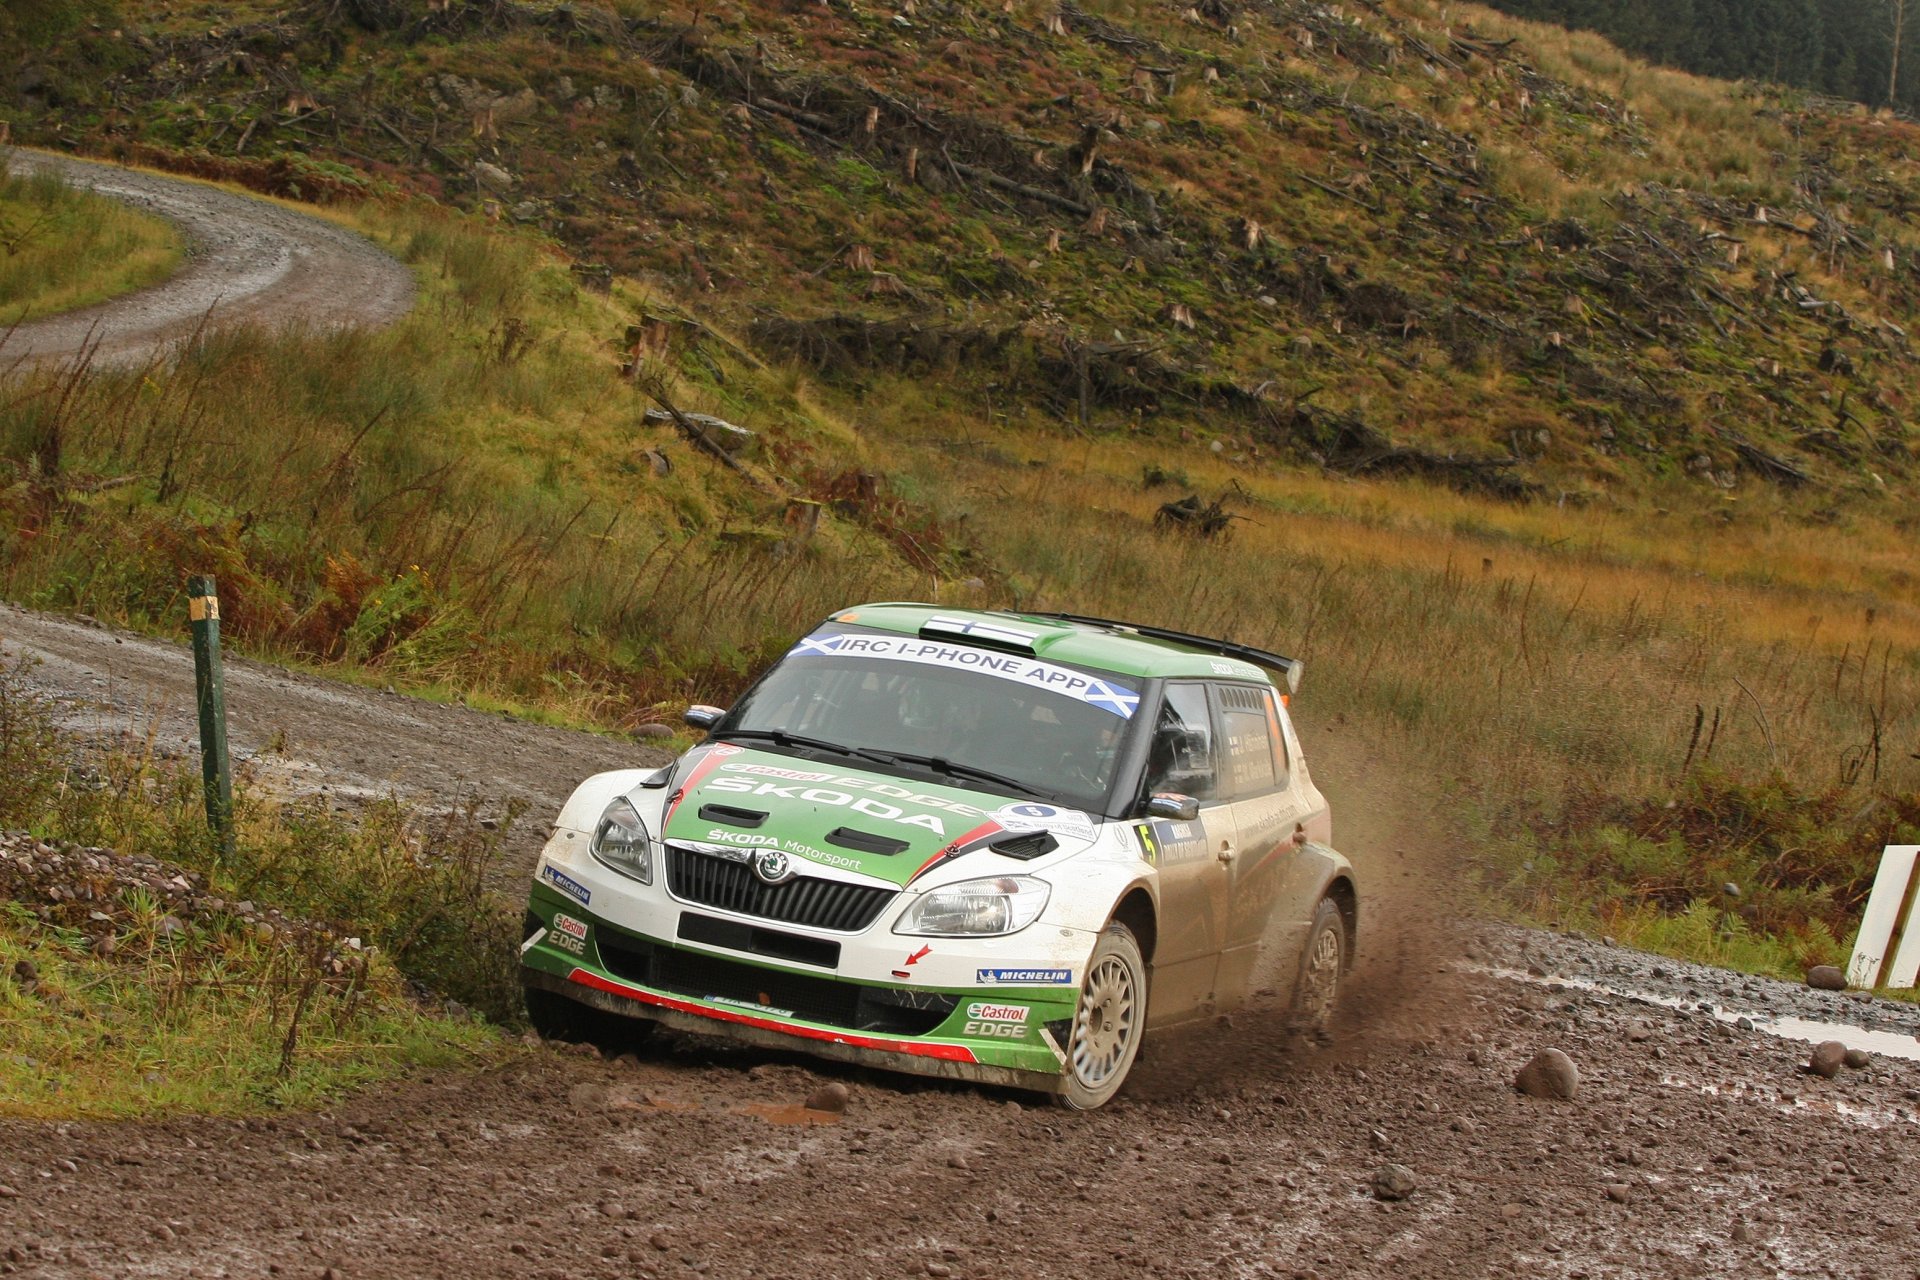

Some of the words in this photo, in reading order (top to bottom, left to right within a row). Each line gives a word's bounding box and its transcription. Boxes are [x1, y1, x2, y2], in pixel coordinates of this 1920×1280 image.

[840, 638, 891, 652] IRC
[896, 643, 1022, 674] I-PHONE
[1025, 667, 1087, 690] APP
[744, 765, 829, 781] Castrol
[828, 777, 984, 818] EDGE
[704, 776, 946, 835] ŠKODA
[1025, 806, 1043, 817] 5
[707, 829, 779, 847] ŠKODA
[784, 839, 862, 870] Motorsport
[1138, 825, 1156, 865] 5
[555, 875, 589, 900] MICHELIN
[562, 918, 585, 937] Castrol
[548, 930, 586, 955] EDGE
[1000, 971, 1068, 980] MICHELIN
[981, 1005, 1025, 1020] Castrol
[962, 1021, 1028, 1038] EDGE
